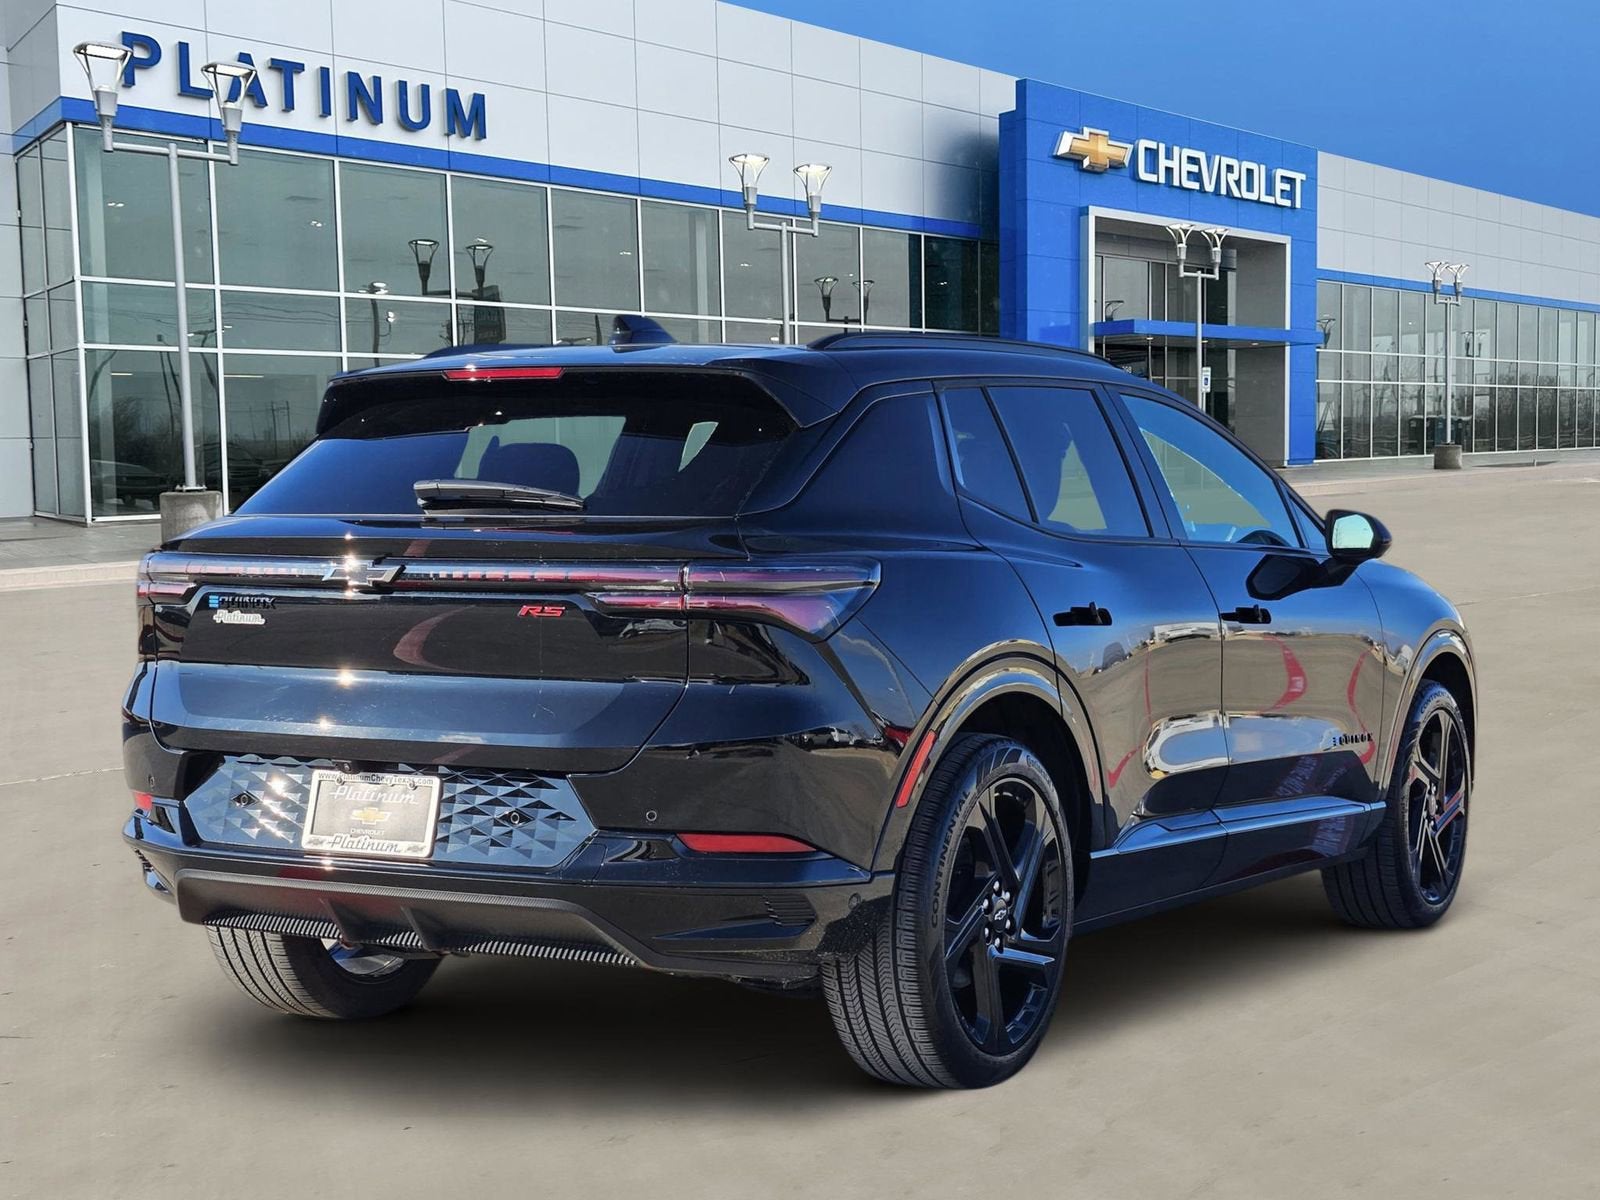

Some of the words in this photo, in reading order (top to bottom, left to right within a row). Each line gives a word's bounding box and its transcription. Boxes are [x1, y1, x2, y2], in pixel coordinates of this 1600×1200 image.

[122, 31, 487, 140] PLATINUM
[1136, 139, 1307, 209] CHEVROLET
[213, 609, 266, 625] Platinum
[517, 605, 566, 618] RS
[318, 772, 434, 786] wwwPlatinumChevyTexas.com
[330, 785, 419, 805] Platinum
[328, 834, 402, 853] Platinum
[931, 791, 971, 929] CONTINENTAL
